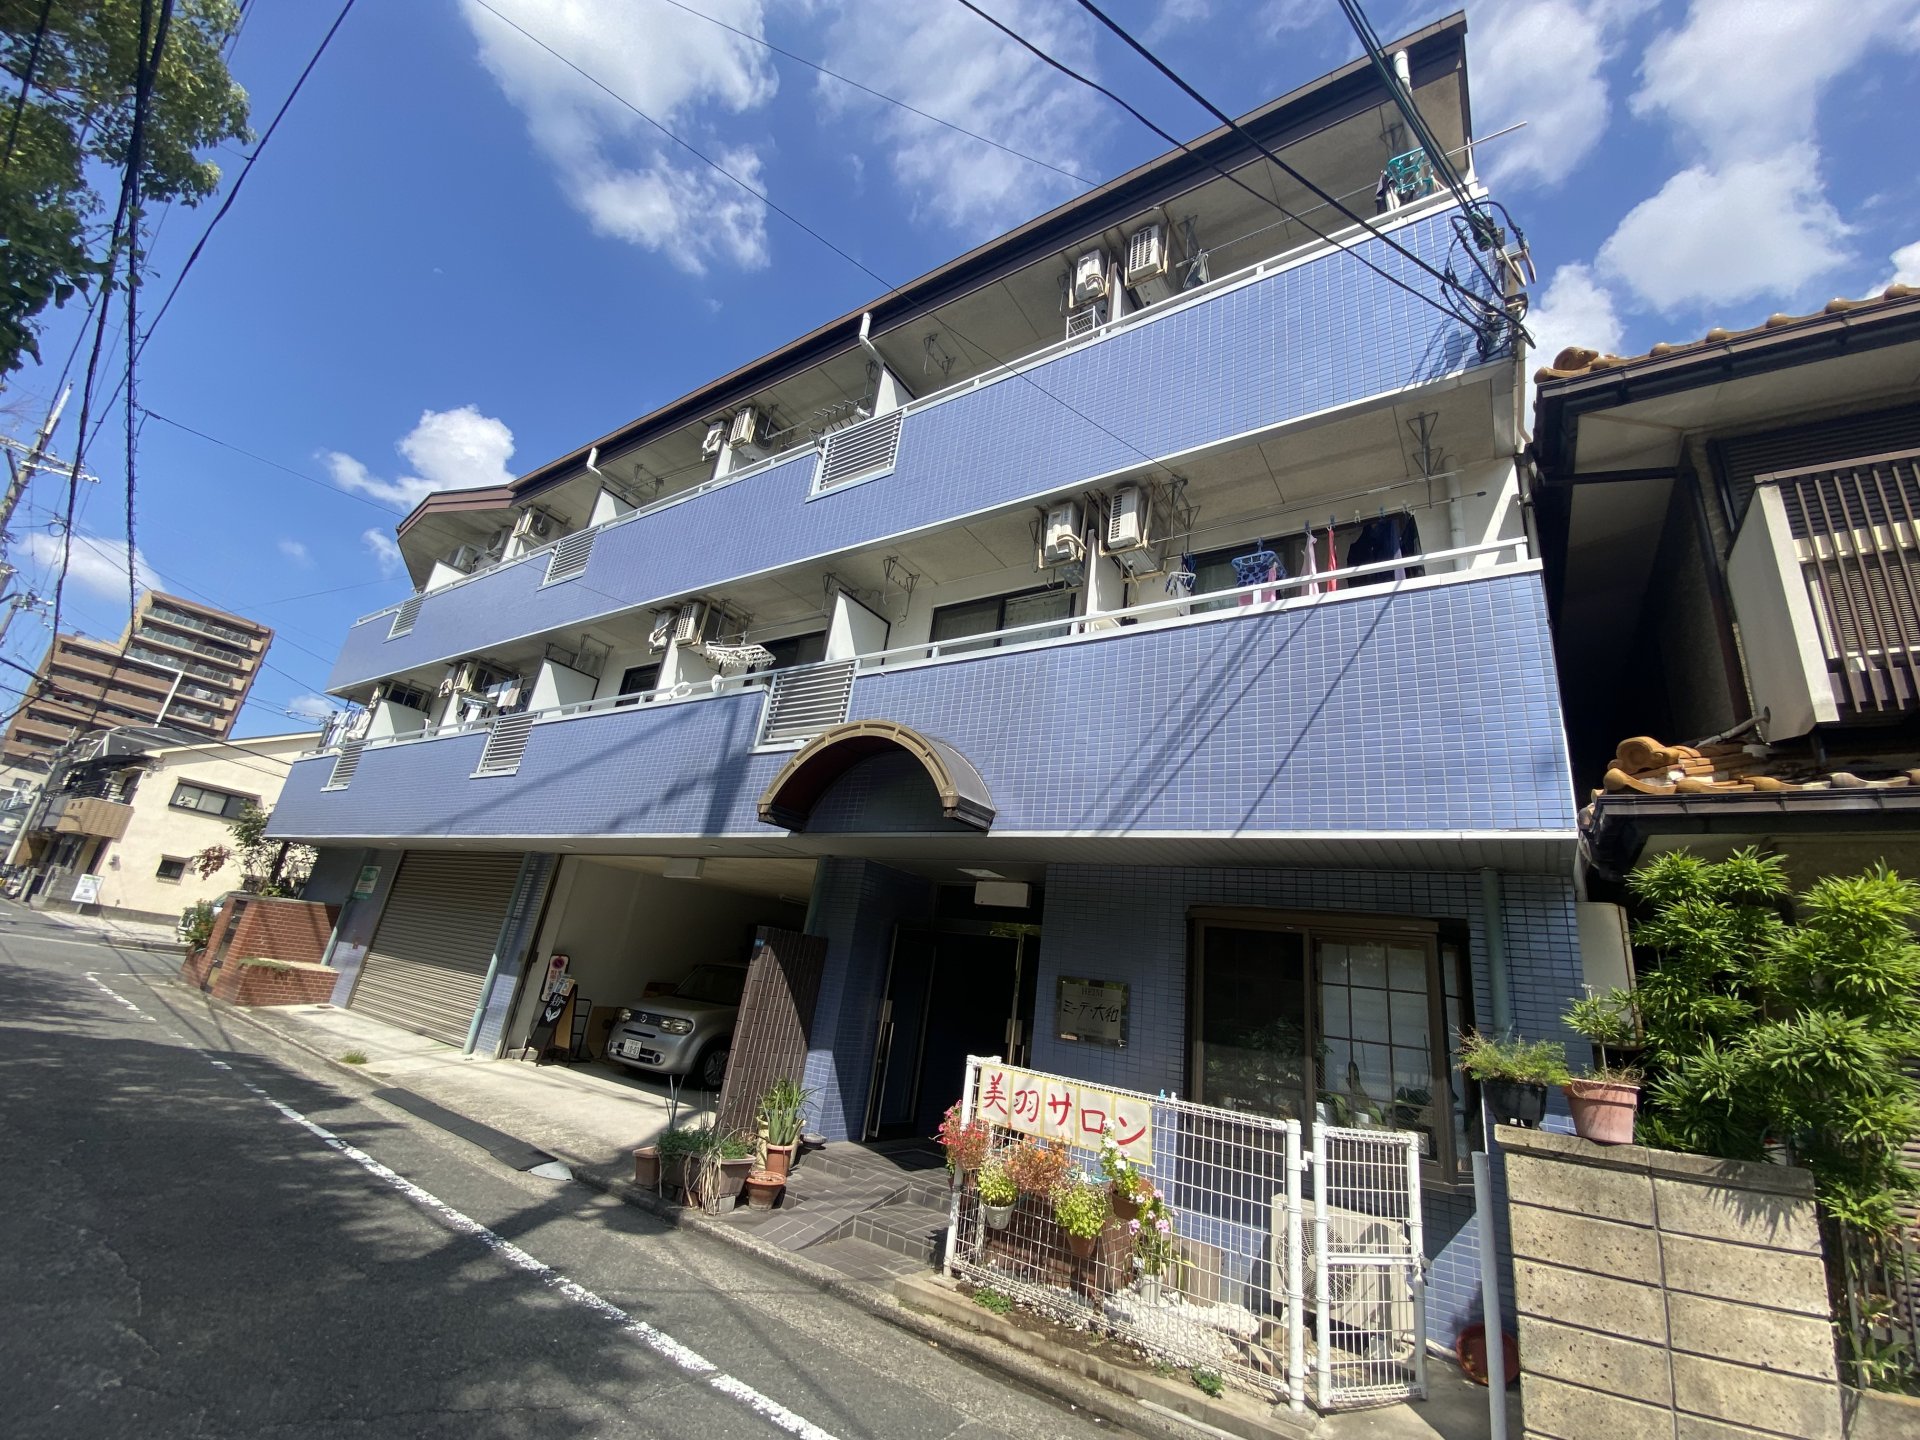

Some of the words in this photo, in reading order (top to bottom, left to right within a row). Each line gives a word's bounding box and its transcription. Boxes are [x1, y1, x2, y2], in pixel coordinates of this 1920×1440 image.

[983, 1071, 1147, 1146] 美羽サロン
